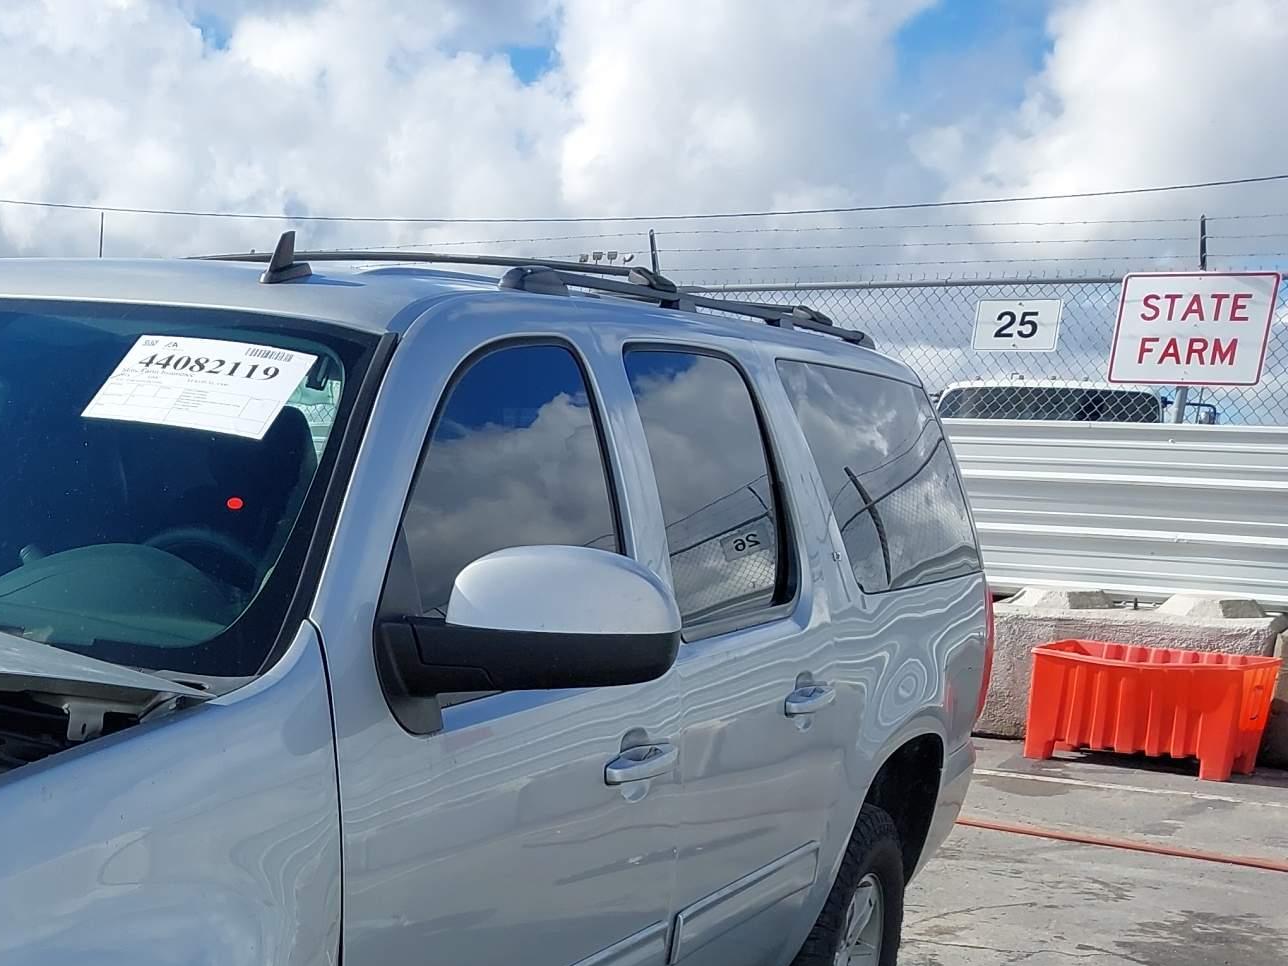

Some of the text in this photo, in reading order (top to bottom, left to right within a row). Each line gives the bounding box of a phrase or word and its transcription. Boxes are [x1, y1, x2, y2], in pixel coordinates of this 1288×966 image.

[1139, 292, 1253, 322] STATE
[992, 310, 1039, 339] 25
[1136, 336, 1239, 366] FARM
[138, 353, 280, 381] 44082119
